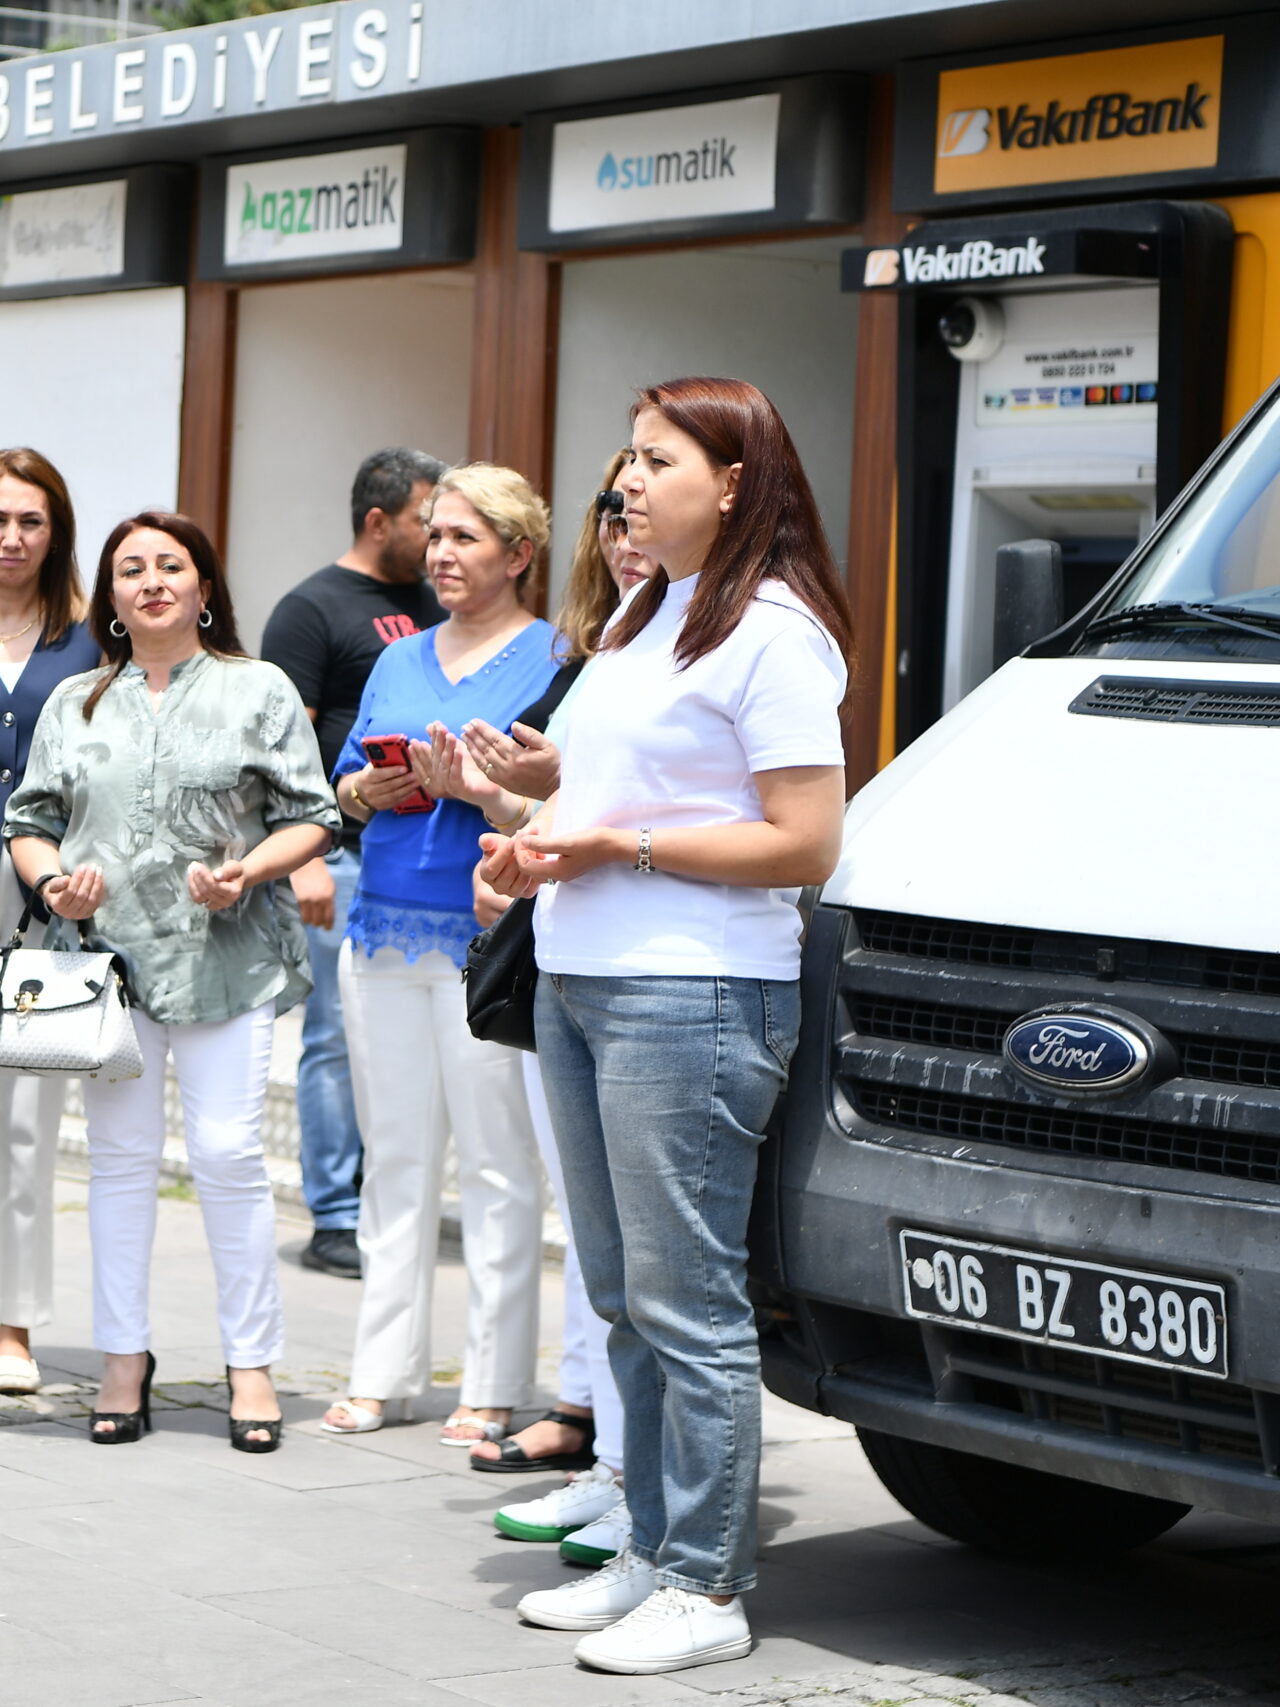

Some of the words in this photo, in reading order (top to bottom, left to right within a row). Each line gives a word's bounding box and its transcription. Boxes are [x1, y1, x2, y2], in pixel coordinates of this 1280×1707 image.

[619, 137, 737, 190] sumatik
[261, 165, 398, 235] gazmatik
[1028, 1025, 1108, 1072] Ford
[932, 1249, 988, 1319] 06
[1016, 1263, 1076, 1338] BZ
[1098, 1279, 1218, 1364] 8380
